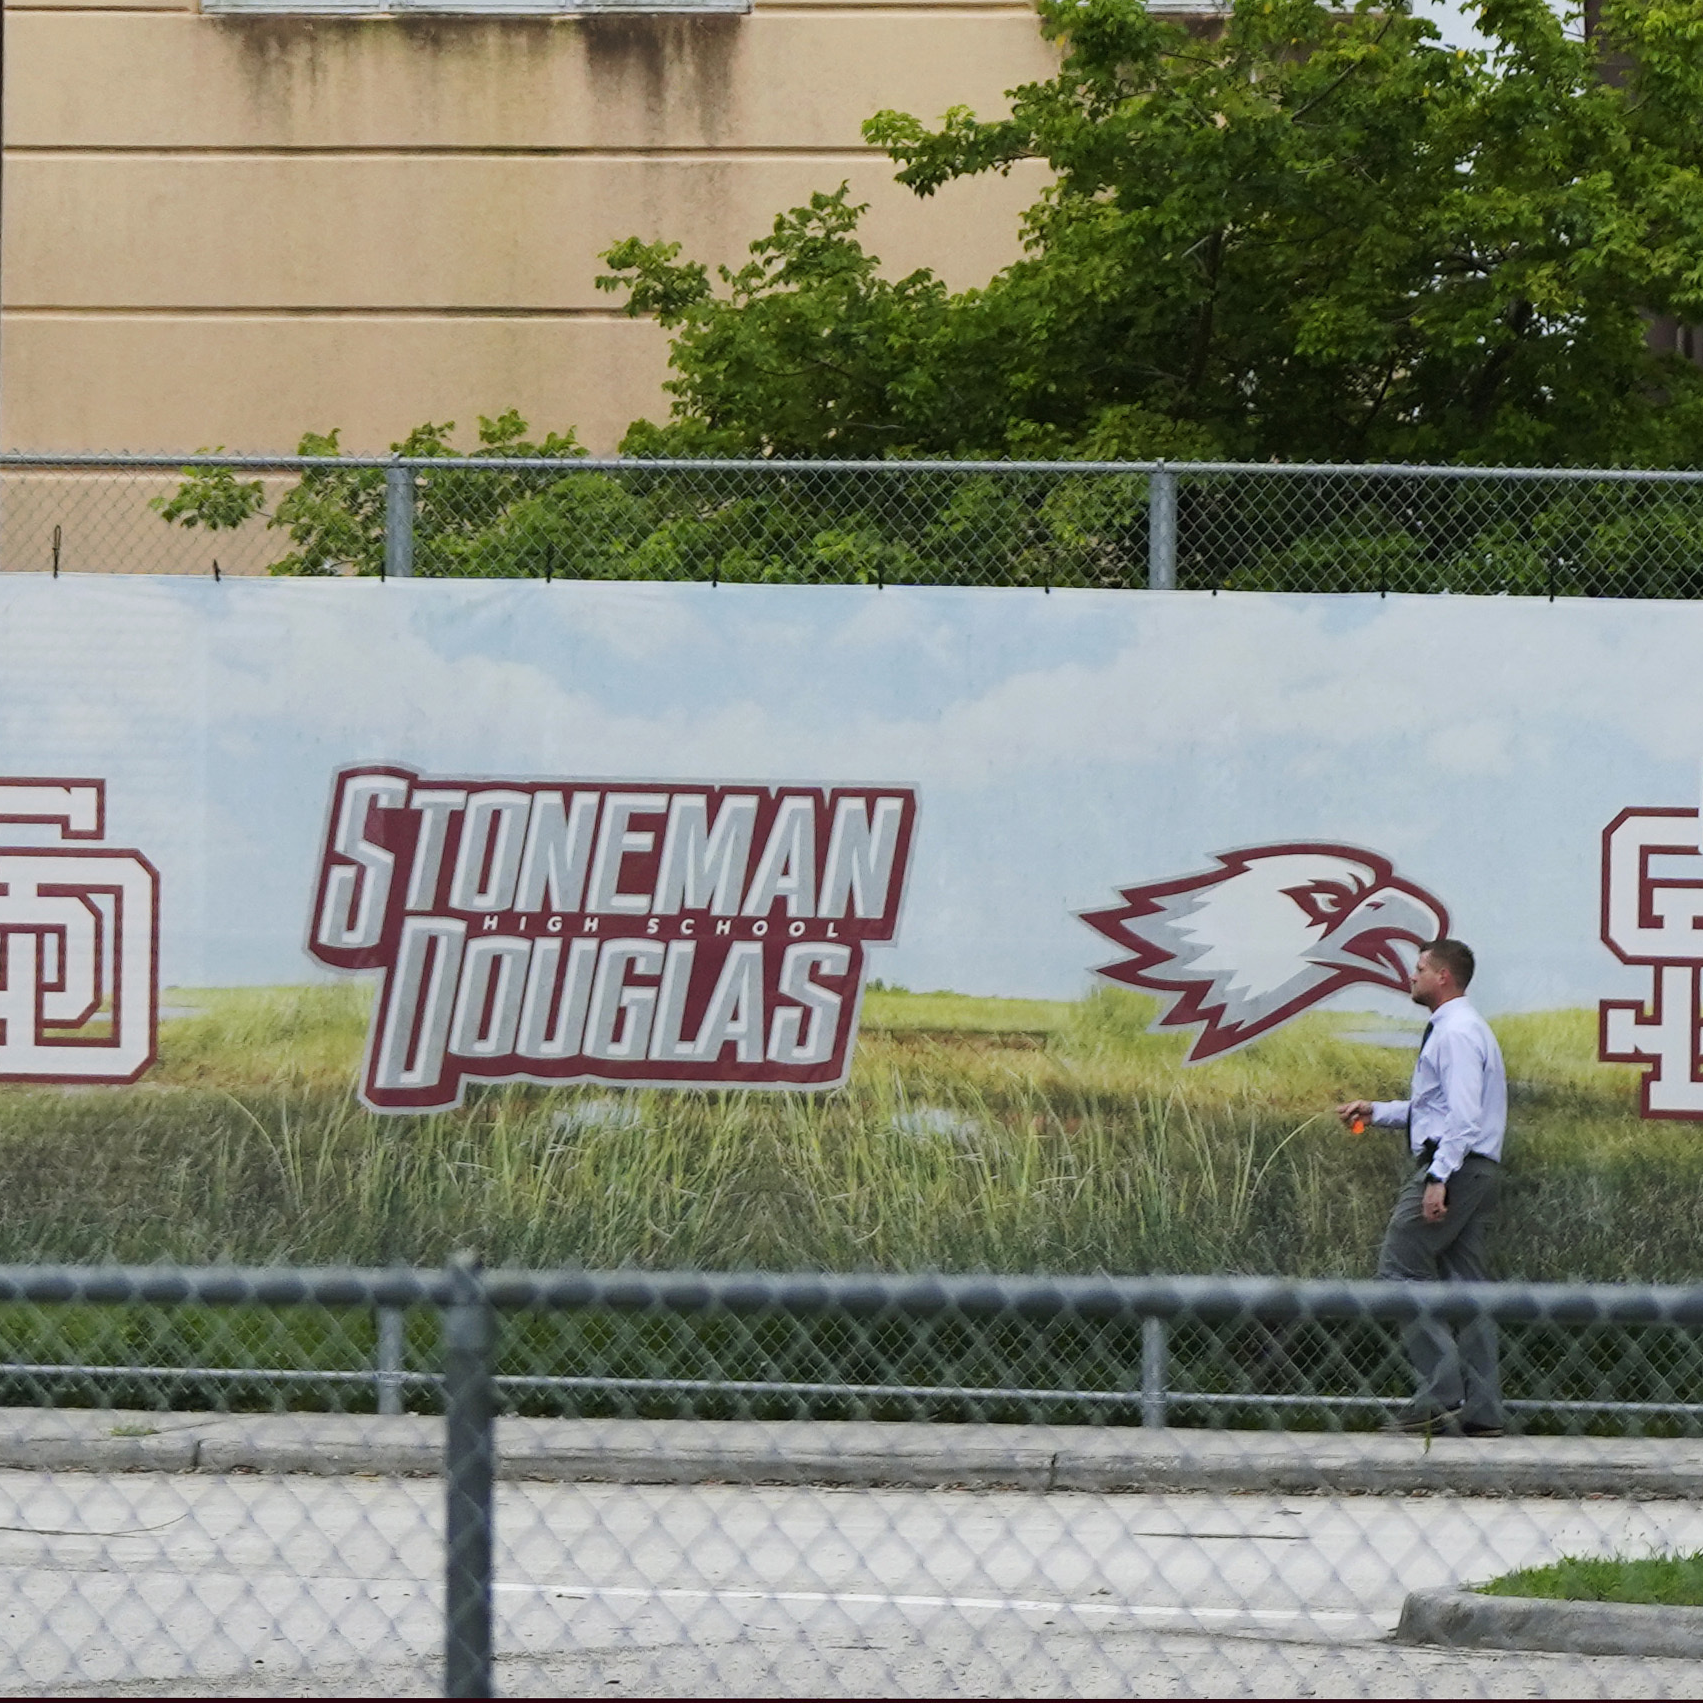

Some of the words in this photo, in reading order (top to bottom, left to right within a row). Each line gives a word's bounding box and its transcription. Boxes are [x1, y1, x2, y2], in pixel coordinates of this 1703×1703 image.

[316, 773, 905, 949] STONEMAN
[481, 914, 601, 934] HIGH
[645, 917, 841, 938] SCHOOL
[373, 915, 854, 1090] DOUGLAS
